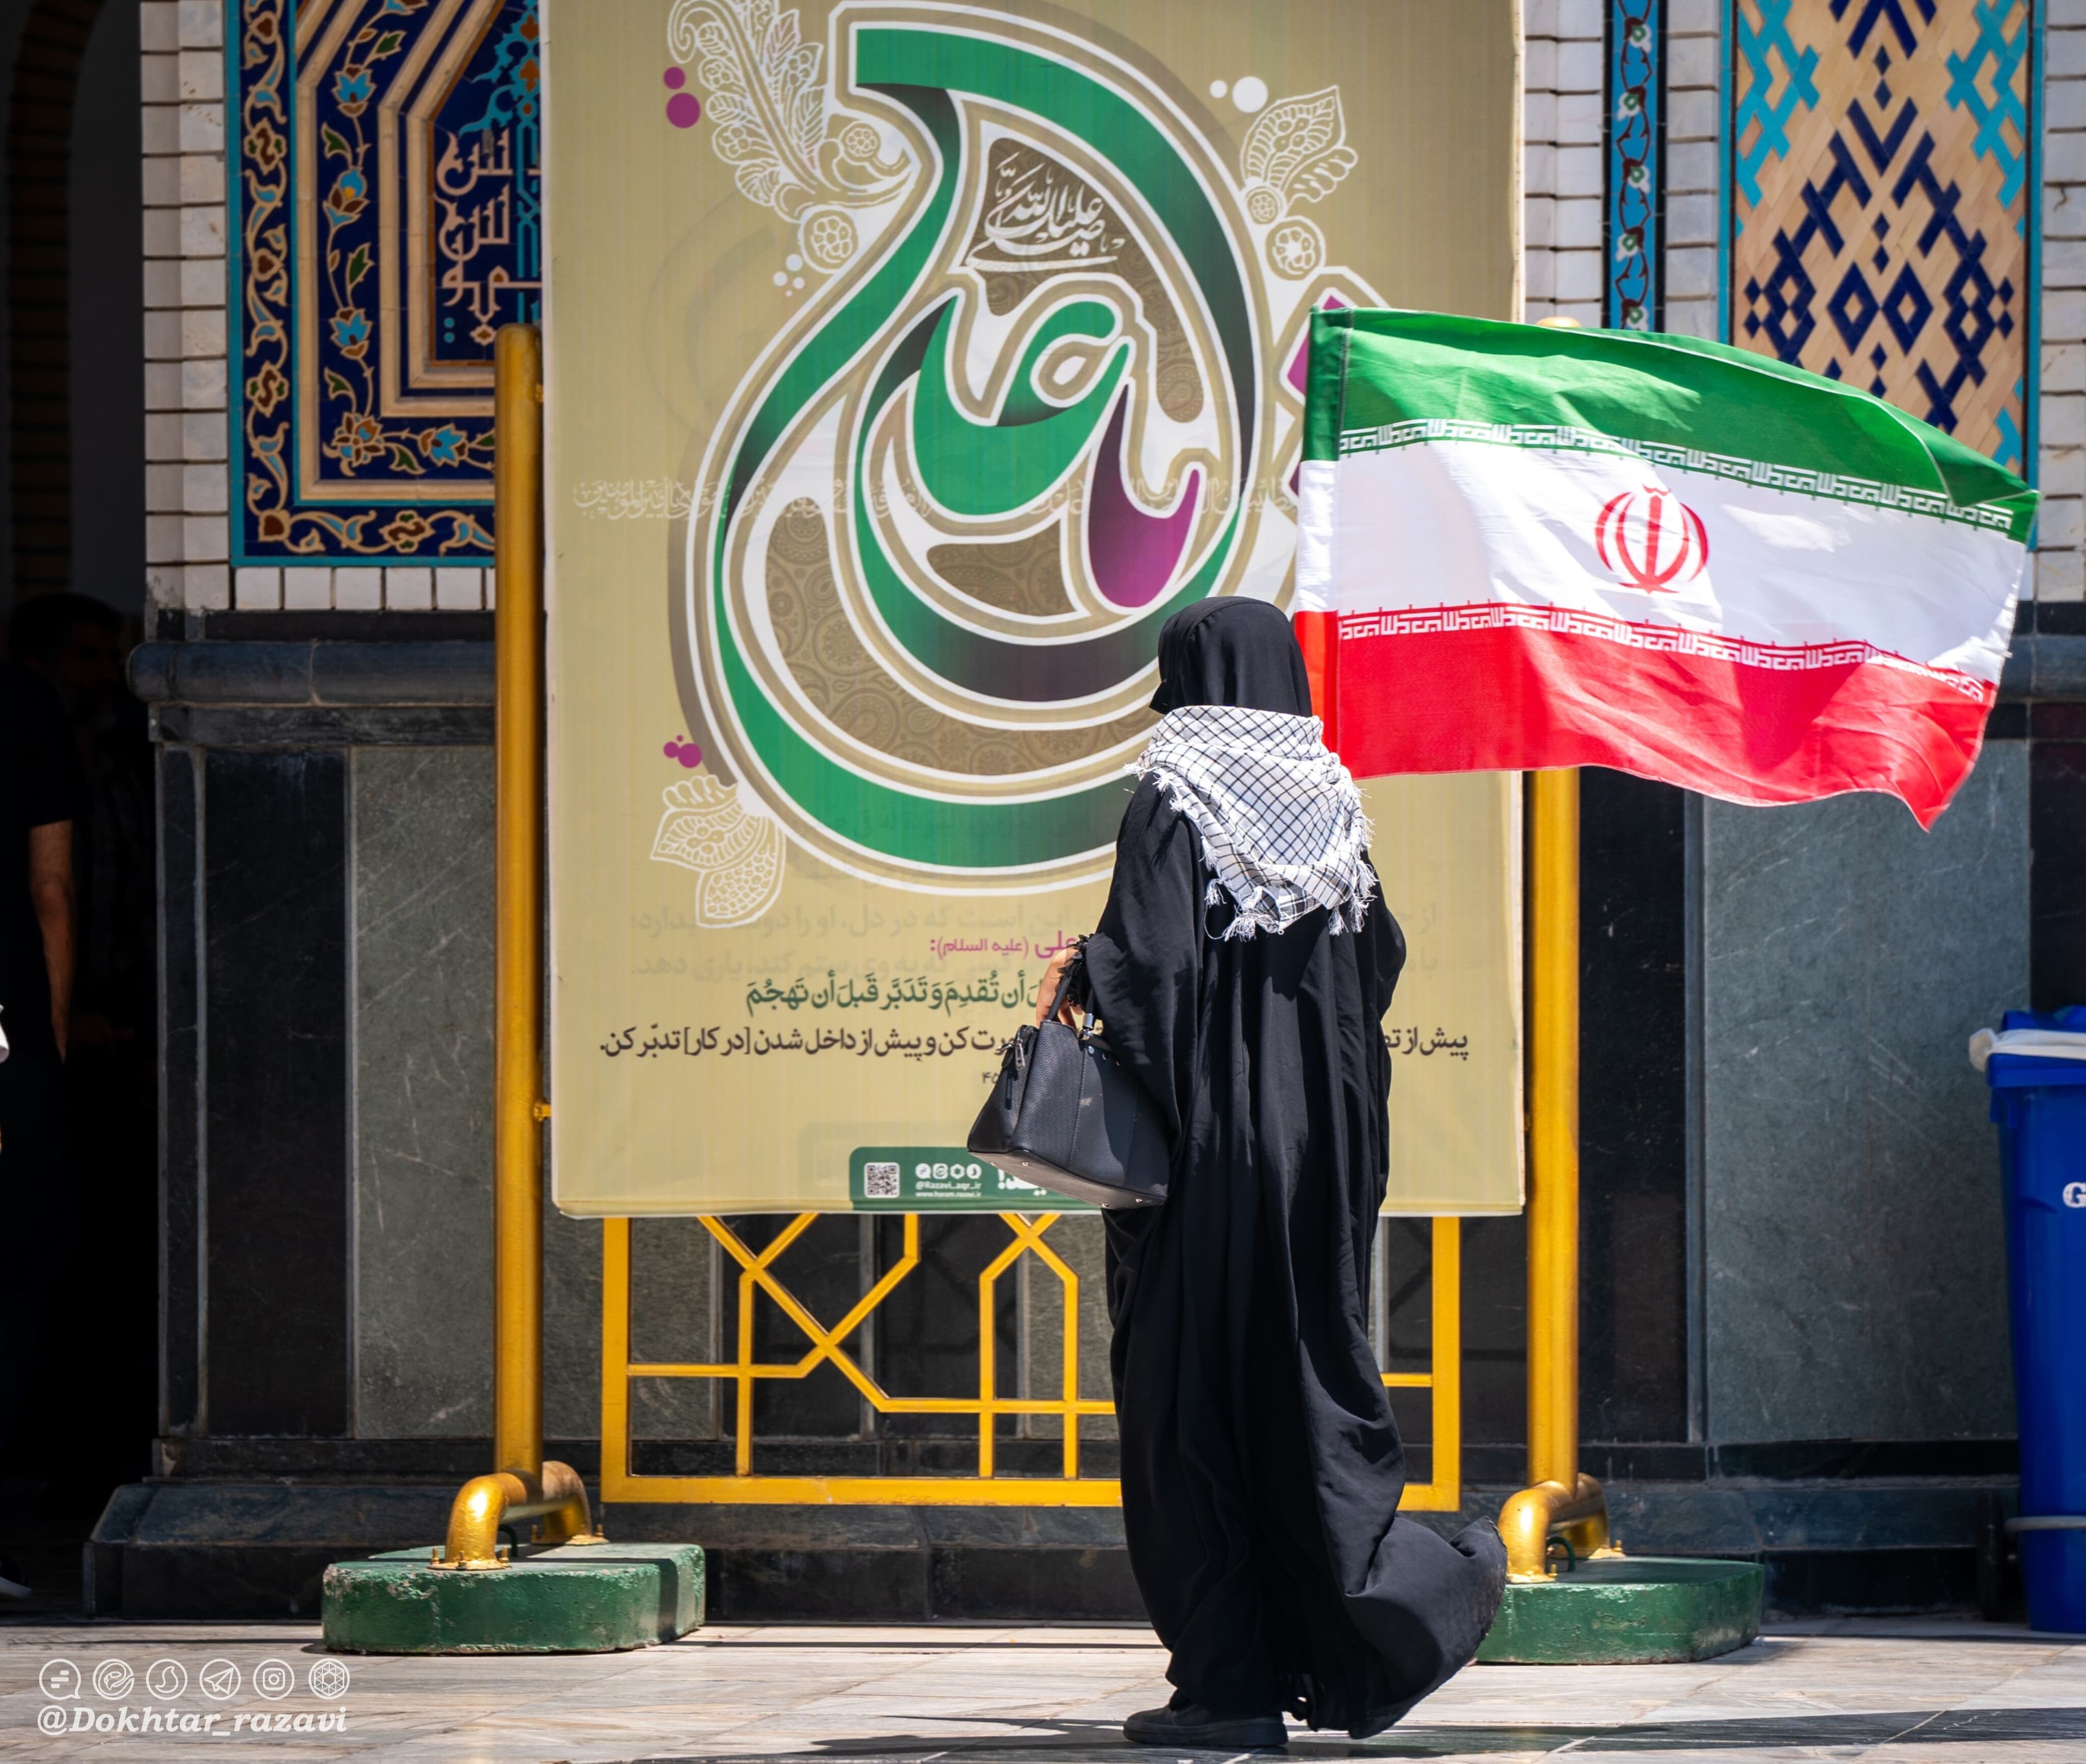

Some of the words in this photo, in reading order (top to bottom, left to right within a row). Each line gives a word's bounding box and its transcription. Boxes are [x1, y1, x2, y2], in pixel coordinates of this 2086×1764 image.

[754, 1028, 803, 1056] شدن
[805, 1028, 857, 1055] داخل
[874, 1028, 923, 1061] پیش
[1419, 1027, 1469, 1061] پیش
